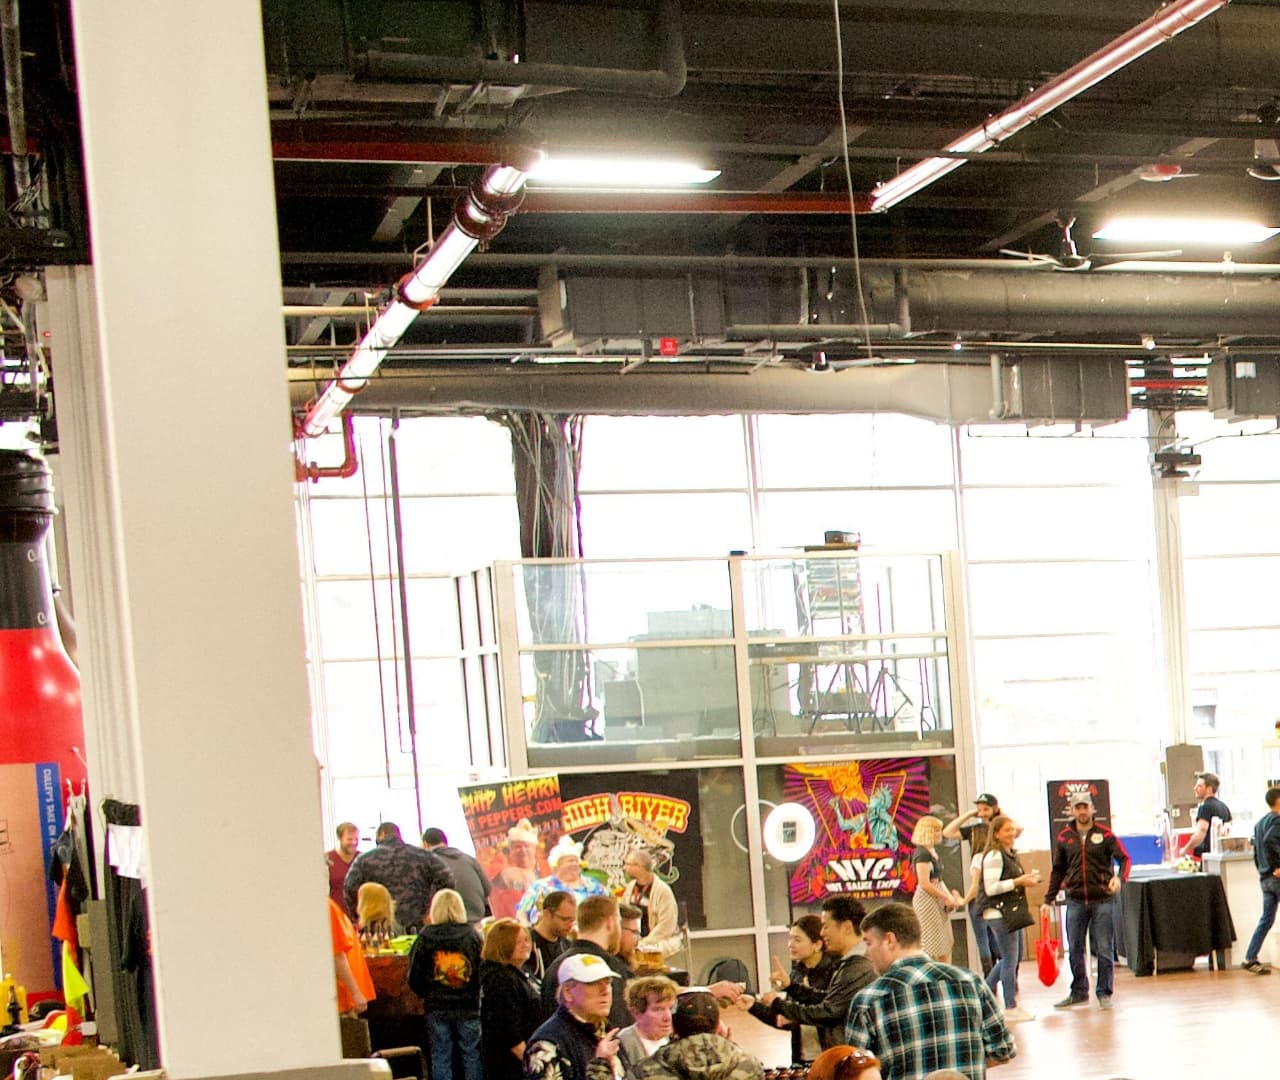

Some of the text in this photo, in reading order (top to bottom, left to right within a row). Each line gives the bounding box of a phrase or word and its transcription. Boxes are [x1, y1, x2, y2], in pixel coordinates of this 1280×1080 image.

[502, 776, 560, 807] HEARN
[562, 797, 609, 831] HIGH
[620, 795, 687, 829] RIVER
[828, 858, 894, 881] NYC
